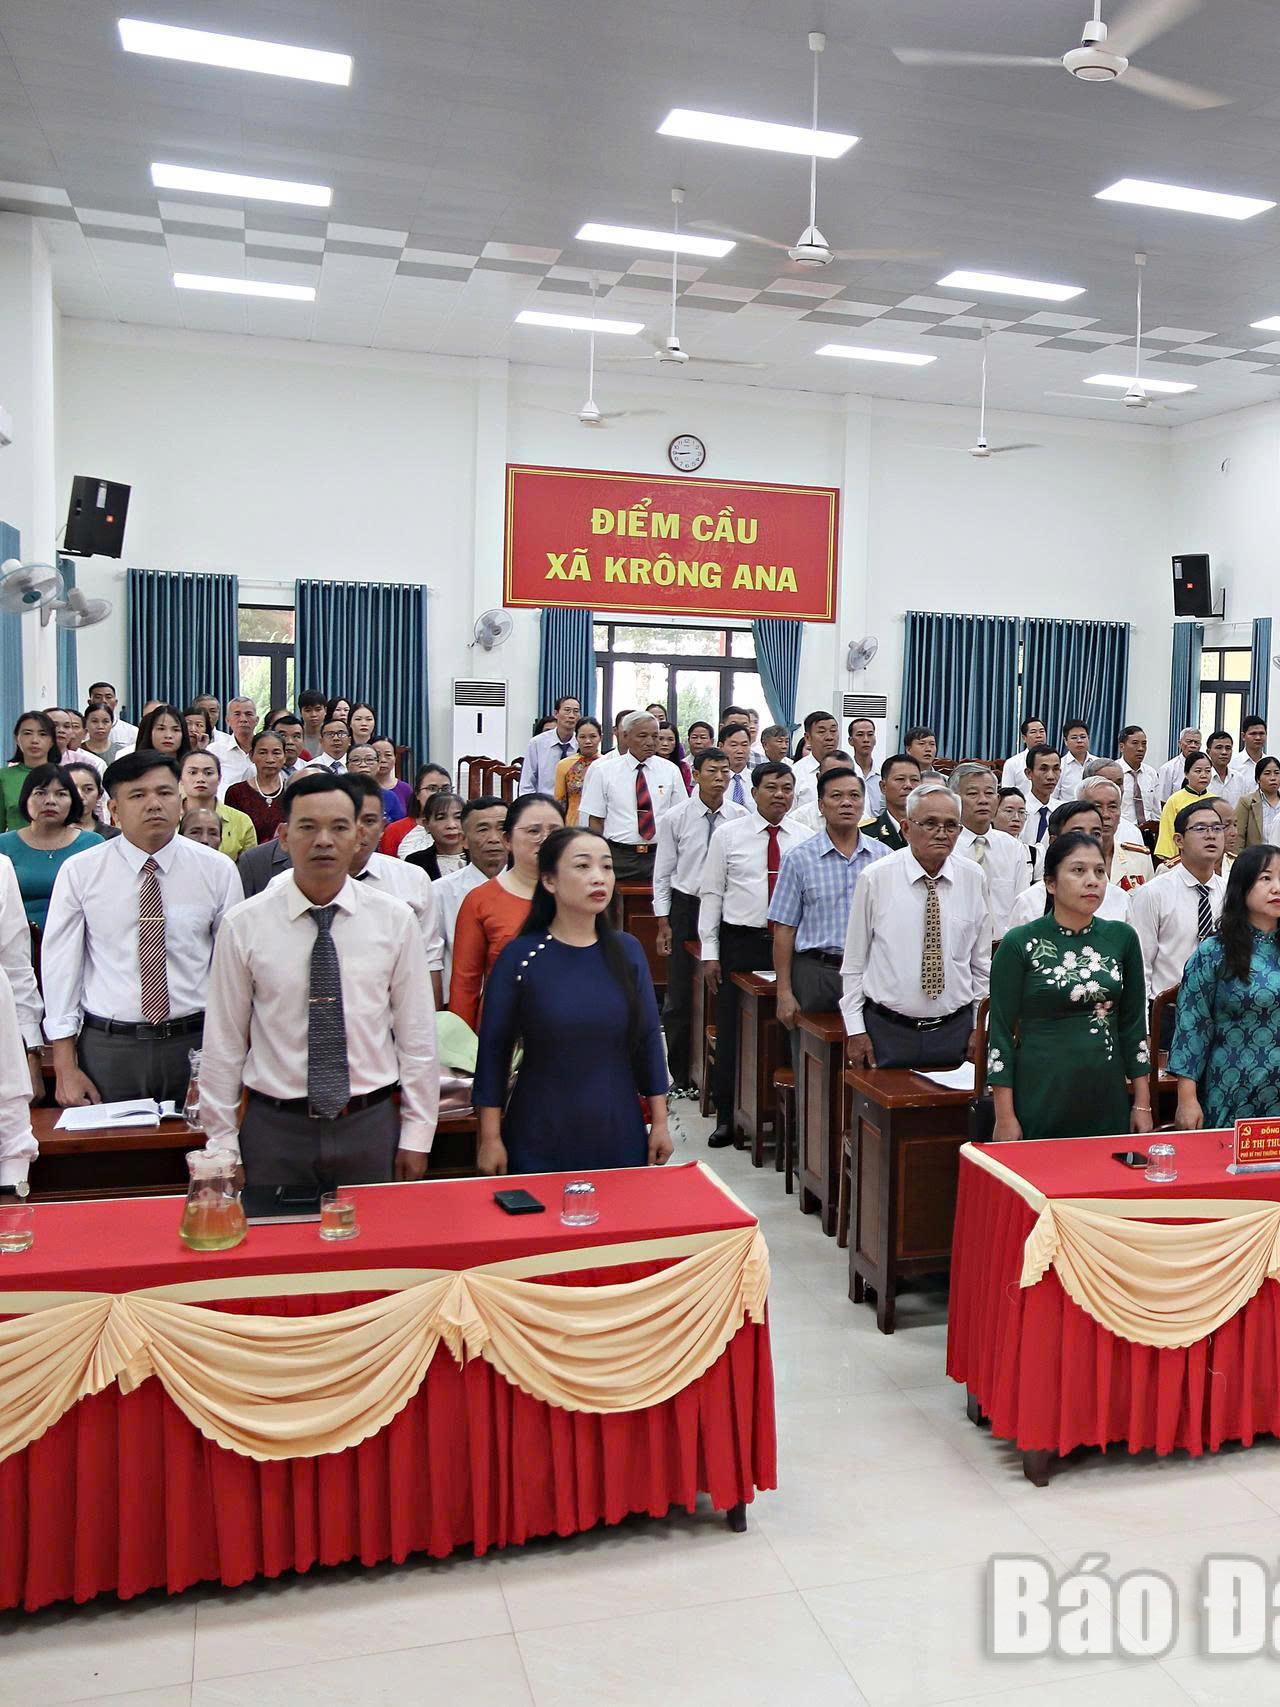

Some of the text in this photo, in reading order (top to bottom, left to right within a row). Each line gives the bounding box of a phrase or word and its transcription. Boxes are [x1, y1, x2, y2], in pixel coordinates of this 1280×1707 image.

[591, 497, 758, 544] ĐIỂM CẦU
[544, 548, 798, 593] XÃ KRÔNG ANA
[1253, 1139, 1264, 1149] THỊ
[1267, 1138, 1280, 1147] THU
